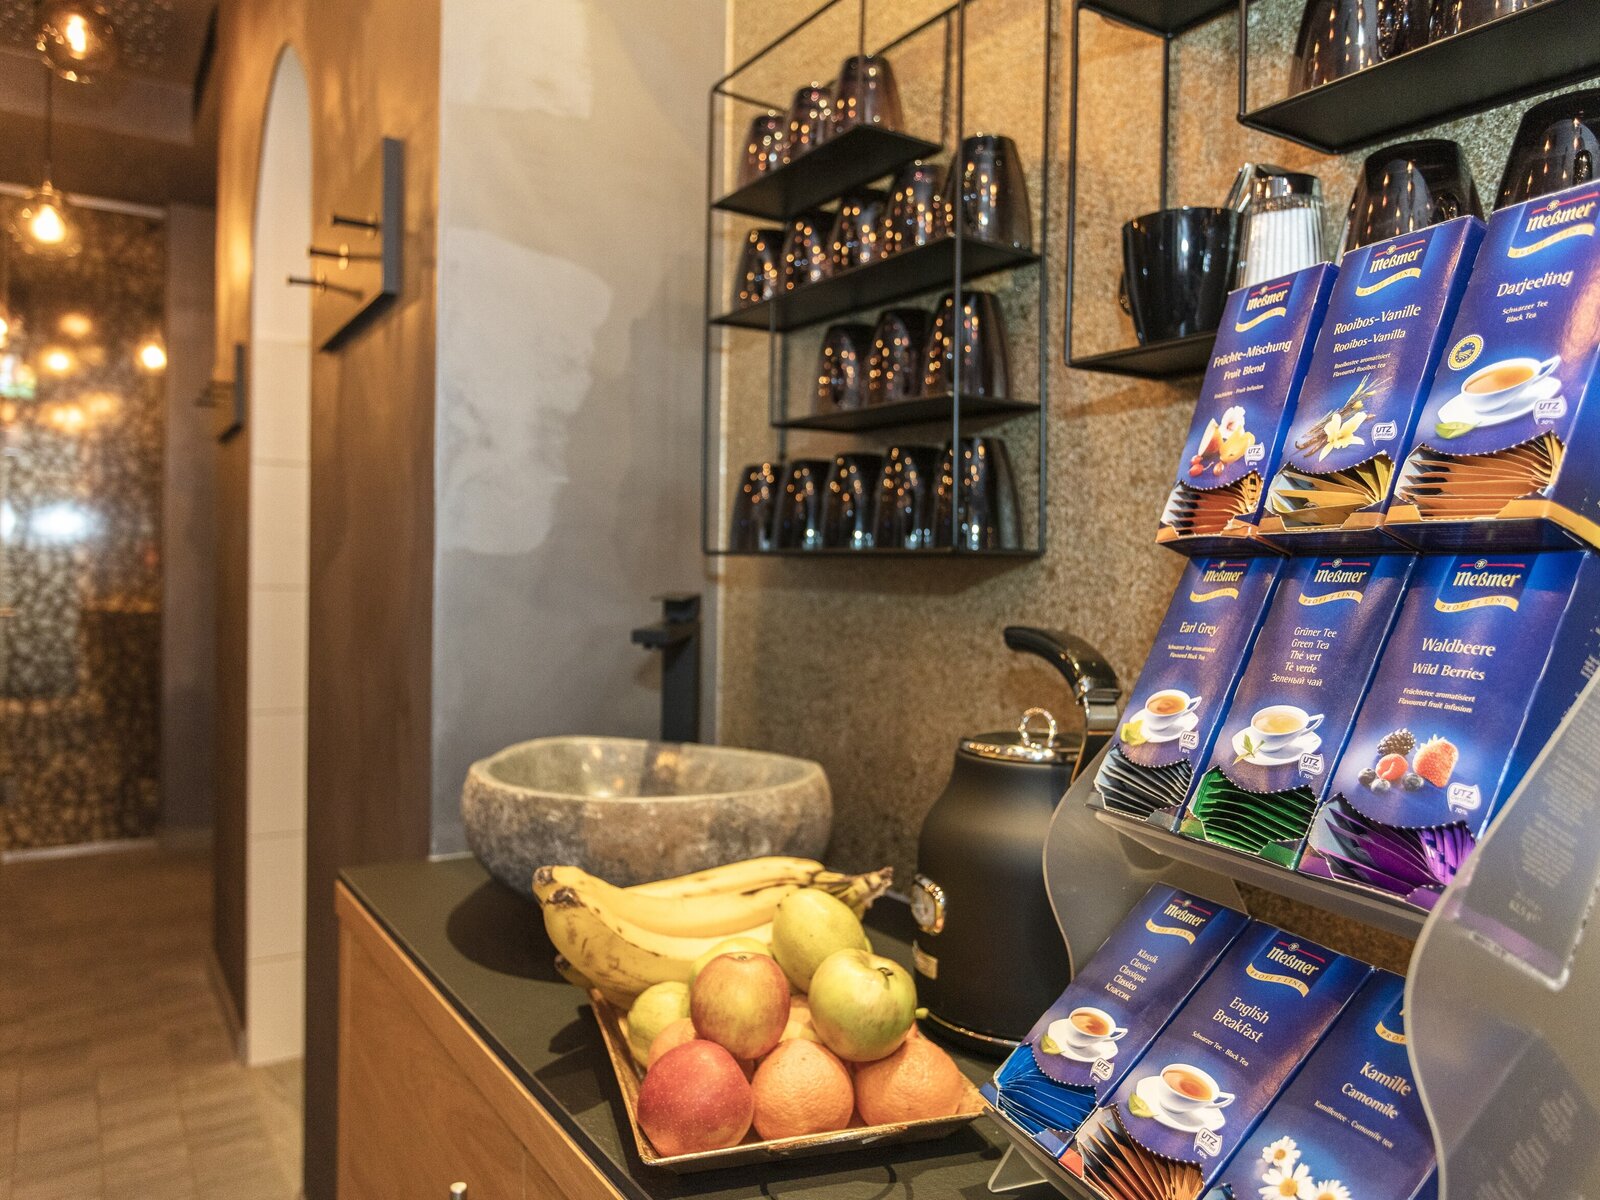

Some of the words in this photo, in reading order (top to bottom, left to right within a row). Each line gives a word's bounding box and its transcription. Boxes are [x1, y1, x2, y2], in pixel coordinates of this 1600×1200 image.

[1525, 201, 1597, 232] Meßmer
[1369, 248, 1423, 273] Meßmer
[1496, 270, 1574, 297] Darjeeling
[1246, 289, 1288, 312] Meßmer
[1502, 303, 1535, 315] Schwarzer
[1333, 304, 1421, 335] Rooibos-Vanille
[1506, 314, 1523, 323] Black
[1333, 328, 1406, 353] Rooibos-Vanilla
[1213, 340, 1293, 368] Früchte-Mischung
[1223, 369, 1241, 380] Fruit
[1242, 362, 1266, 376] Blend
[1539, 402, 1560, 410] UTZ
[1203, 570, 1244, 583] Meßmer
[1313, 569, 1367, 583] Meßmer
[1452, 571, 1521, 588] Meßmer
[1440, 602, 1470, 611] PROFI
[1180, 622, 1197, 633] Earl
[1197, 622, 1220, 637] Grey
[1294, 626, 1321, 637] Grüner
[1323, 628, 1338, 638] Tee
[1291, 638, 1314, 649] Green
[1316, 640, 1330, 650] Tea
[1421, 637, 1496, 657] Waldbeere
[1290, 650, 1305, 660] Thé
[1306, 653, 1322, 662] vert
[1295, 663, 1318, 674] verde
[1412, 662, 1439, 675] Wild
[1440, 664, 1486, 681] Berries
[1270, 673, 1305, 685] Зеленый
[1306, 678, 1323, 687] чай
[1403, 687, 1435, 697] Früchtetee
[1434, 691, 1476, 703] aromatisiert
[1398, 697, 1428, 707] Flavoured
[1427, 700, 1443, 709] fruit
[1444, 702, 1473, 714] infusion
[1183, 733, 1196, 742] UTZ
[1303, 756, 1320, 767] UTZ
[1453, 787, 1474, 799] UTZ
[1163, 903, 1206, 927] Meßmer
[1136, 949, 1159, 964] Klassik
[1266, 946, 1320, 976] Meßmer
[1119, 964, 1147, 984] Classique
[1129, 958, 1151, 973] Classic
[1113, 974, 1138, 991] Classico
[1104, 982, 1132, 1001] Классик
[1229, 996, 1270, 1025] English
[1212, 1008, 1264, 1043] Breakfast
[1380, 1029, 1405, 1043] PROF
[1192, 1030, 1214, 1046] Schwarzer
[1213, 1041, 1223, 1051] Tee
[1225, 1048, 1239, 1061] Black
[1239, 1057, 1249, 1067] Tea
[1096, 1060, 1111, 1073] UTZ
[1359, 1061, 1412, 1097] Kamille
[1341, 1082, 1399, 1120] Camomile
[1314, 1100, 1348, 1123] Kamillentee
[1351, 1119, 1382, 1142] Camomile
[1201, 1131, 1218, 1147] UTZ
